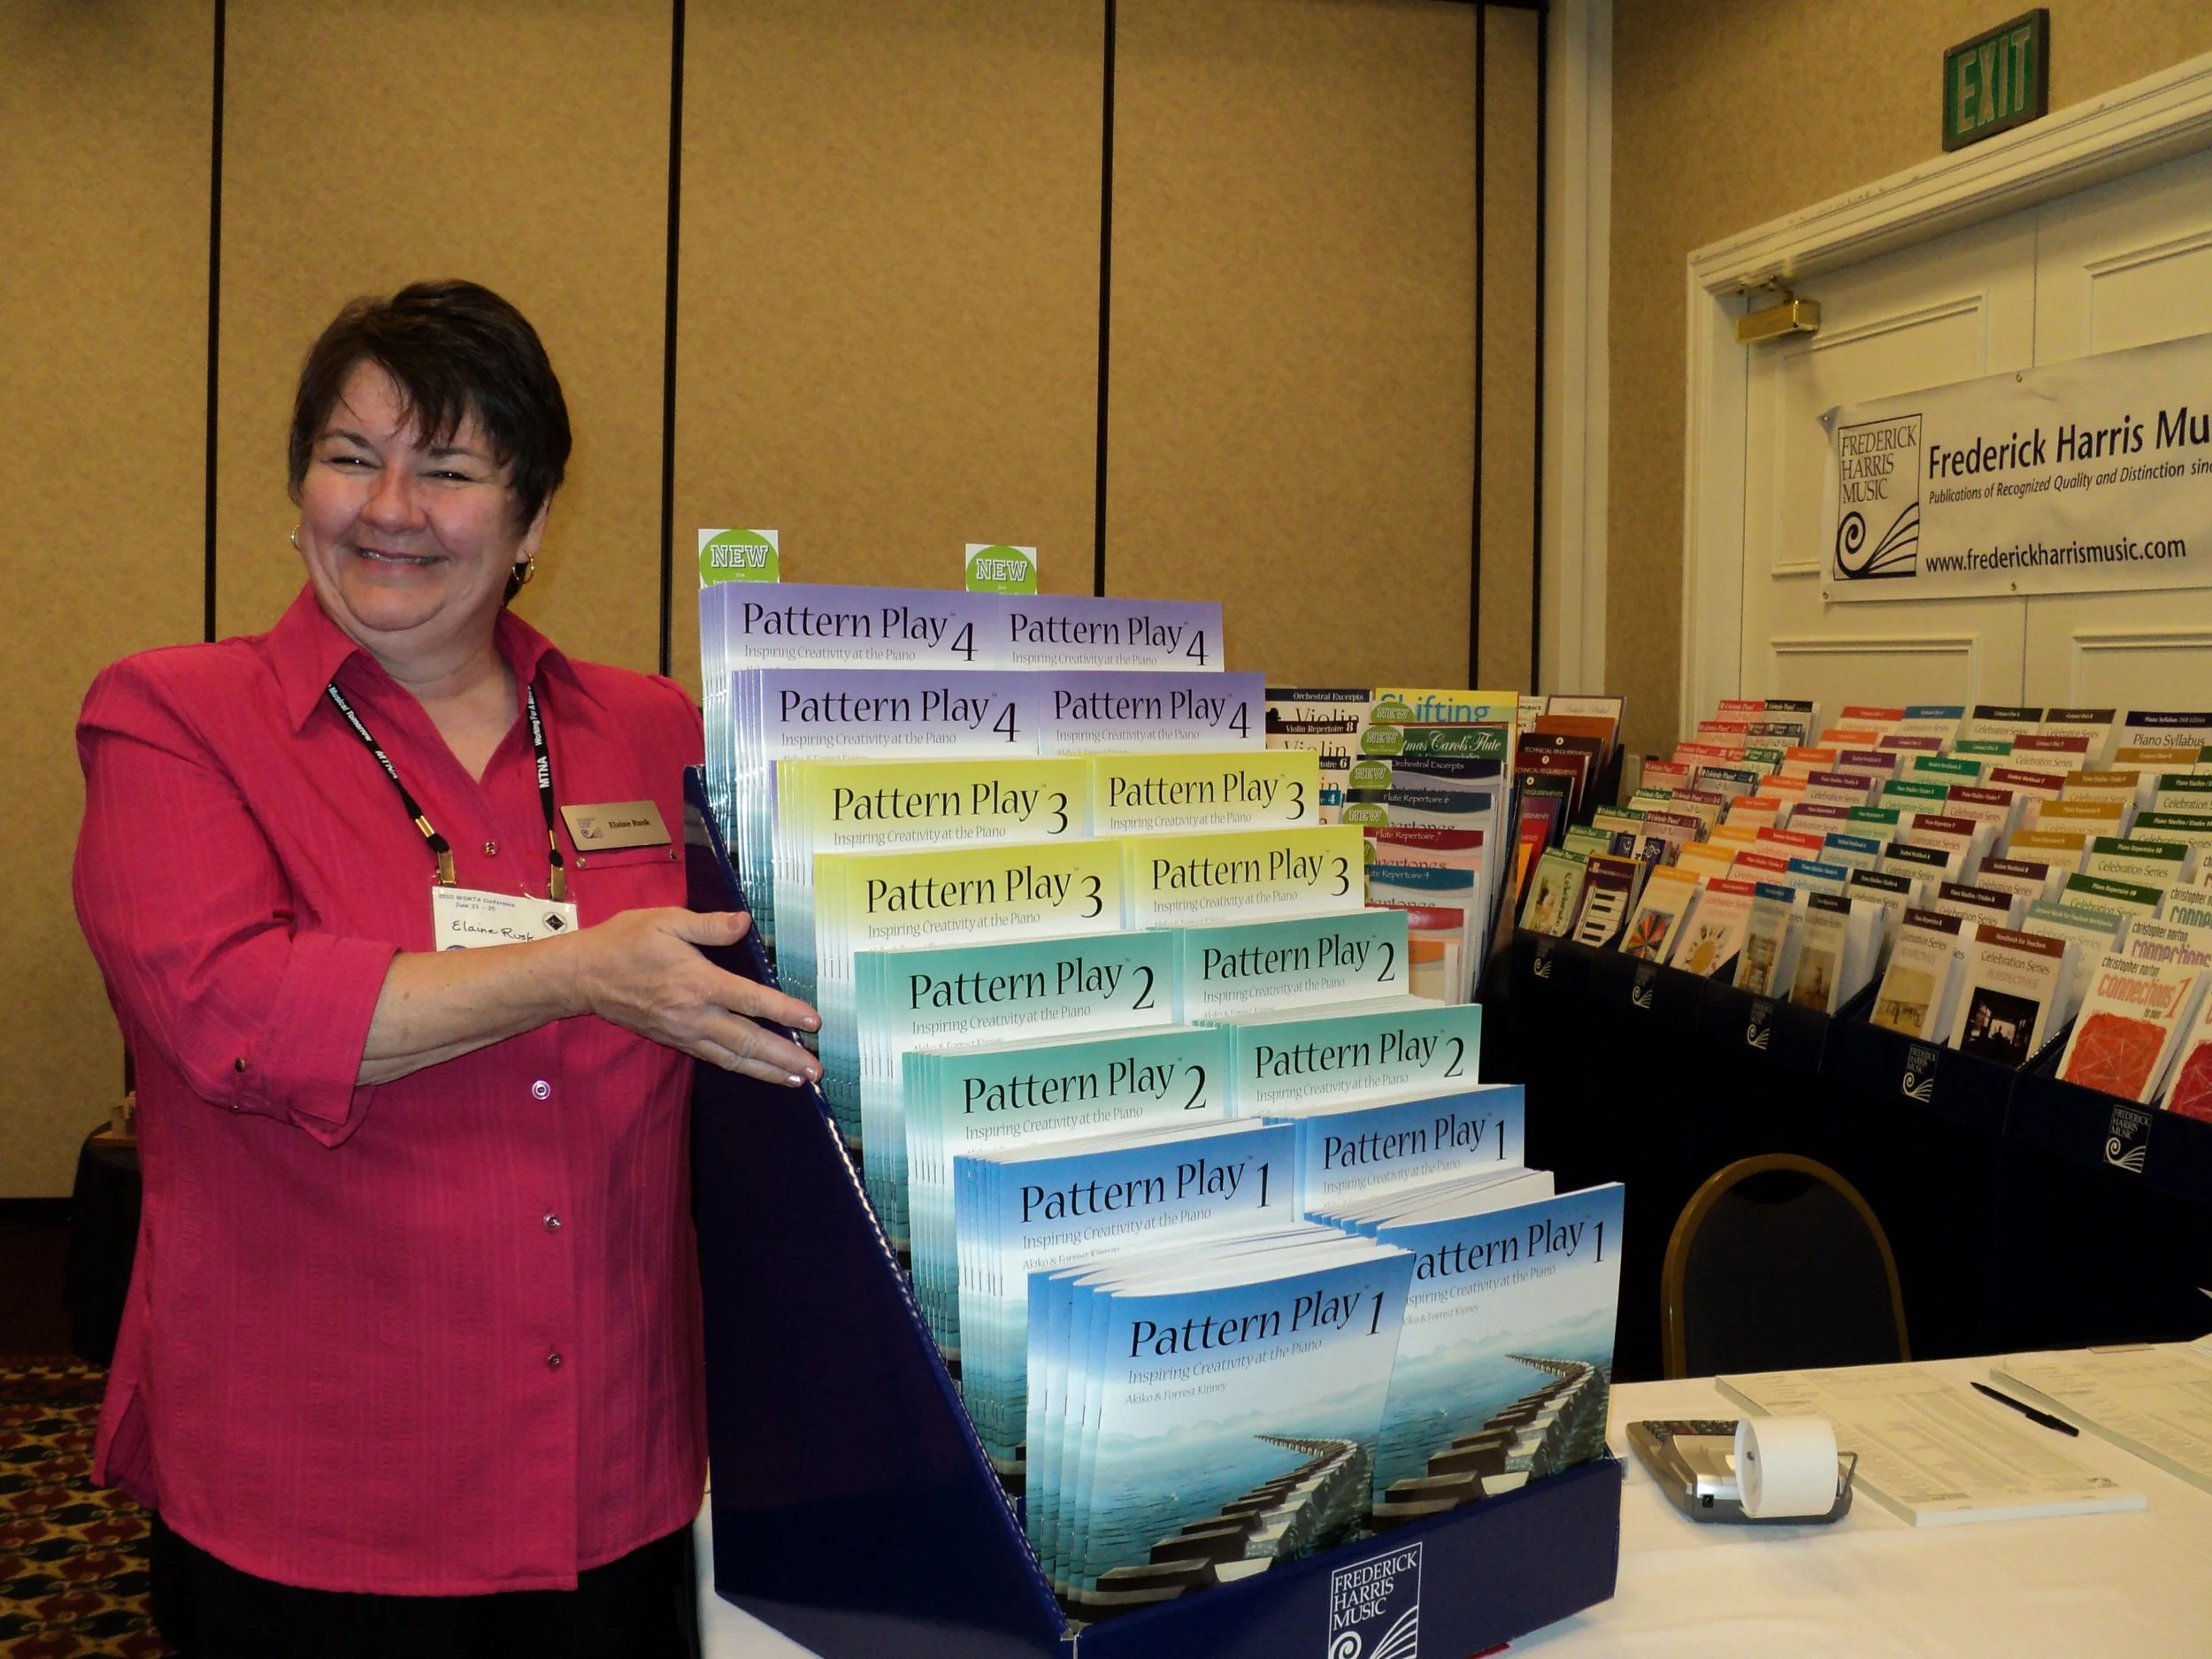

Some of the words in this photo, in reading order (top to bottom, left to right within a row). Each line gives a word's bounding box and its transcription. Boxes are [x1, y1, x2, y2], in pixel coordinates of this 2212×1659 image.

[1956, 27, 2031, 134] EXIT
[1841, 425, 1917, 457] FREDERICK
[1929, 428, 2047, 479] Frederick
[2056, 414, 2144, 463] Harris
[2155, 407, 2210, 449] Mu
[1842, 453, 1894, 480] HARRIS
[1929, 487, 1981, 504] Publications
[1985, 483, 1994, 497] of
[1997, 475, 2051, 499] Recognized
[2055, 472, 2093, 491] Quality
[2096, 468, 2117, 486] and
[2120, 462, 2185, 483] Distinction
[1842, 478, 1889, 504] MUSIC
[710, 544, 769, 568] NEW
[976, 558, 1028, 582] NEW
[1926, 536, 2186, 572] www.frederickharrismusic.com
[743, 603, 872, 638] Pattern
[951, 622, 979, 662] 4
[1010, 613, 1120, 645] Pattern
[1186, 630, 1210, 665] 4
[1293, 692, 1330, 702] Orchestral
[1333, 693, 1363, 702] Excerpts
[328, 687, 349, 711] Musical
[346, 710, 372, 741] Tomorrow
[780, 689, 910, 723] Pattern
[992, 703, 1020, 743] 4
[1054, 690, 1162, 720] Pattern
[1228, 702, 1252, 739] 4
[1286, 724, 1307, 733] Violin
[1308, 724, 1344, 733] Repertoire
[1346, 722, 1354, 732] 8
[1377, 708, 1409, 720] NEW
[533, 720, 542, 746] Working
[1367, 733, 1398, 744] NEW
[2133, 733, 2162, 746] Piano
[2163, 733, 2205, 748] Syllabus
[375, 750, 398, 779] MTNA
[537, 756, 549, 788] MTNA
[1356, 768, 1386, 780] NEW
[1431, 761, 1464, 771] Excerpts
[833, 787, 962, 821] Pattern
[1047, 792, 1068, 835] 3
[1109, 776, 1214, 807] Pattern
[1286, 781, 1305, 820] 3
[1402, 795, 1442, 804] Repertoire
[1349, 810, 1382, 822] NEW
[1394, 832, 1435, 842] Repertoire
[1152, 857, 1261, 891] Pattern
[1330, 856, 1349, 896] 3
[2098, 860, 2142, 874] Celebration
[2145, 865, 2170, 878] Series
[483, 898, 516, 908] Conference
[866, 876, 995, 914] Pattern
[1080, 874, 1102, 918] 3
[452, 920, 498, 934] Elaine
[868, 925, 921, 939] Inspiring
[922, 918, 975, 935] Creativity
[977, 918, 989, 928] at
[989, 915, 1009, 928] the
[1010, 912, 1041, 926] Piano
[1996, 933, 2017, 943] Handbook
[1203, 946, 1310, 980] Pattern
[1377, 941, 1395, 982] 2
[1981, 950, 2025, 969] Celebration
[2027, 960, 2050, 975] Series
[2101, 956, 2139, 974] christopher
[2139, 964, 2160, 977] norton
[910, 972, 1047, 1010] Pattern
[1132, 965, 1155, 1010] 2
[2097, 972, 2176, 1008] connections
[2165, 976, 2193, 1018] 1
[912, 1021, 968, 1036] Inspiring
[969, 1011, 1025, 1030] Creativity
[1026, 1011, 1039, 1022] at
[1041, 1008, 1059, 1021] the
[1061, 1004, 1091, 1018] Piano
[1256, 1041, 1371, 1079] Pattern
[1443, 1037, 1464, 1078] 2
[964, 1073, 1099, 1114] Pattern
[1184, 1064, 1207, 1110] 2
[1324, 1127, 1426, 1170] Pattern
[1494, 1119, 1507, 1161] 1
[1020, 1175, 1165, 1223] Pattern
[1256, 1162, 1271, 1209] 1
[1023, 1230, 1081, 1249] Inspiring
[1084, 1221, 1142, 1240] Creativity
[1144, 1218, 1156, 1230] at
[1159, 1213, 1178, 1227] the
[1180, 1207, 1211, 1224] Piano
[1413, 1237, 1518, 1280] attern
[1594, 1220, 1604, 1264] 1
[1129, 1310, 1280, 1358] Pattern
[1366, 1291, 1385, 1337] 1
[1128, 1367, 1190, 1385] Inspiring
[1193, 1356, 1255, 1377] Creativity
[1256, 1353, 1267, 1364] at
[1270, 1347, 1289, 1362] the
[1291, 1340, 1322, 1356] Piano
[1125, 1394, 1153, 1405] Akiko
[1164, 1389, 1195, 1401] Forrest
[1197, 1381, 1227, 1396] Kinney
[1334, 1550, 1417, 1594] FREDERICK
[1333, 1577, 1394, 1613] HARRIS
[1333, 1597, 1387, 1631] MUSIC
